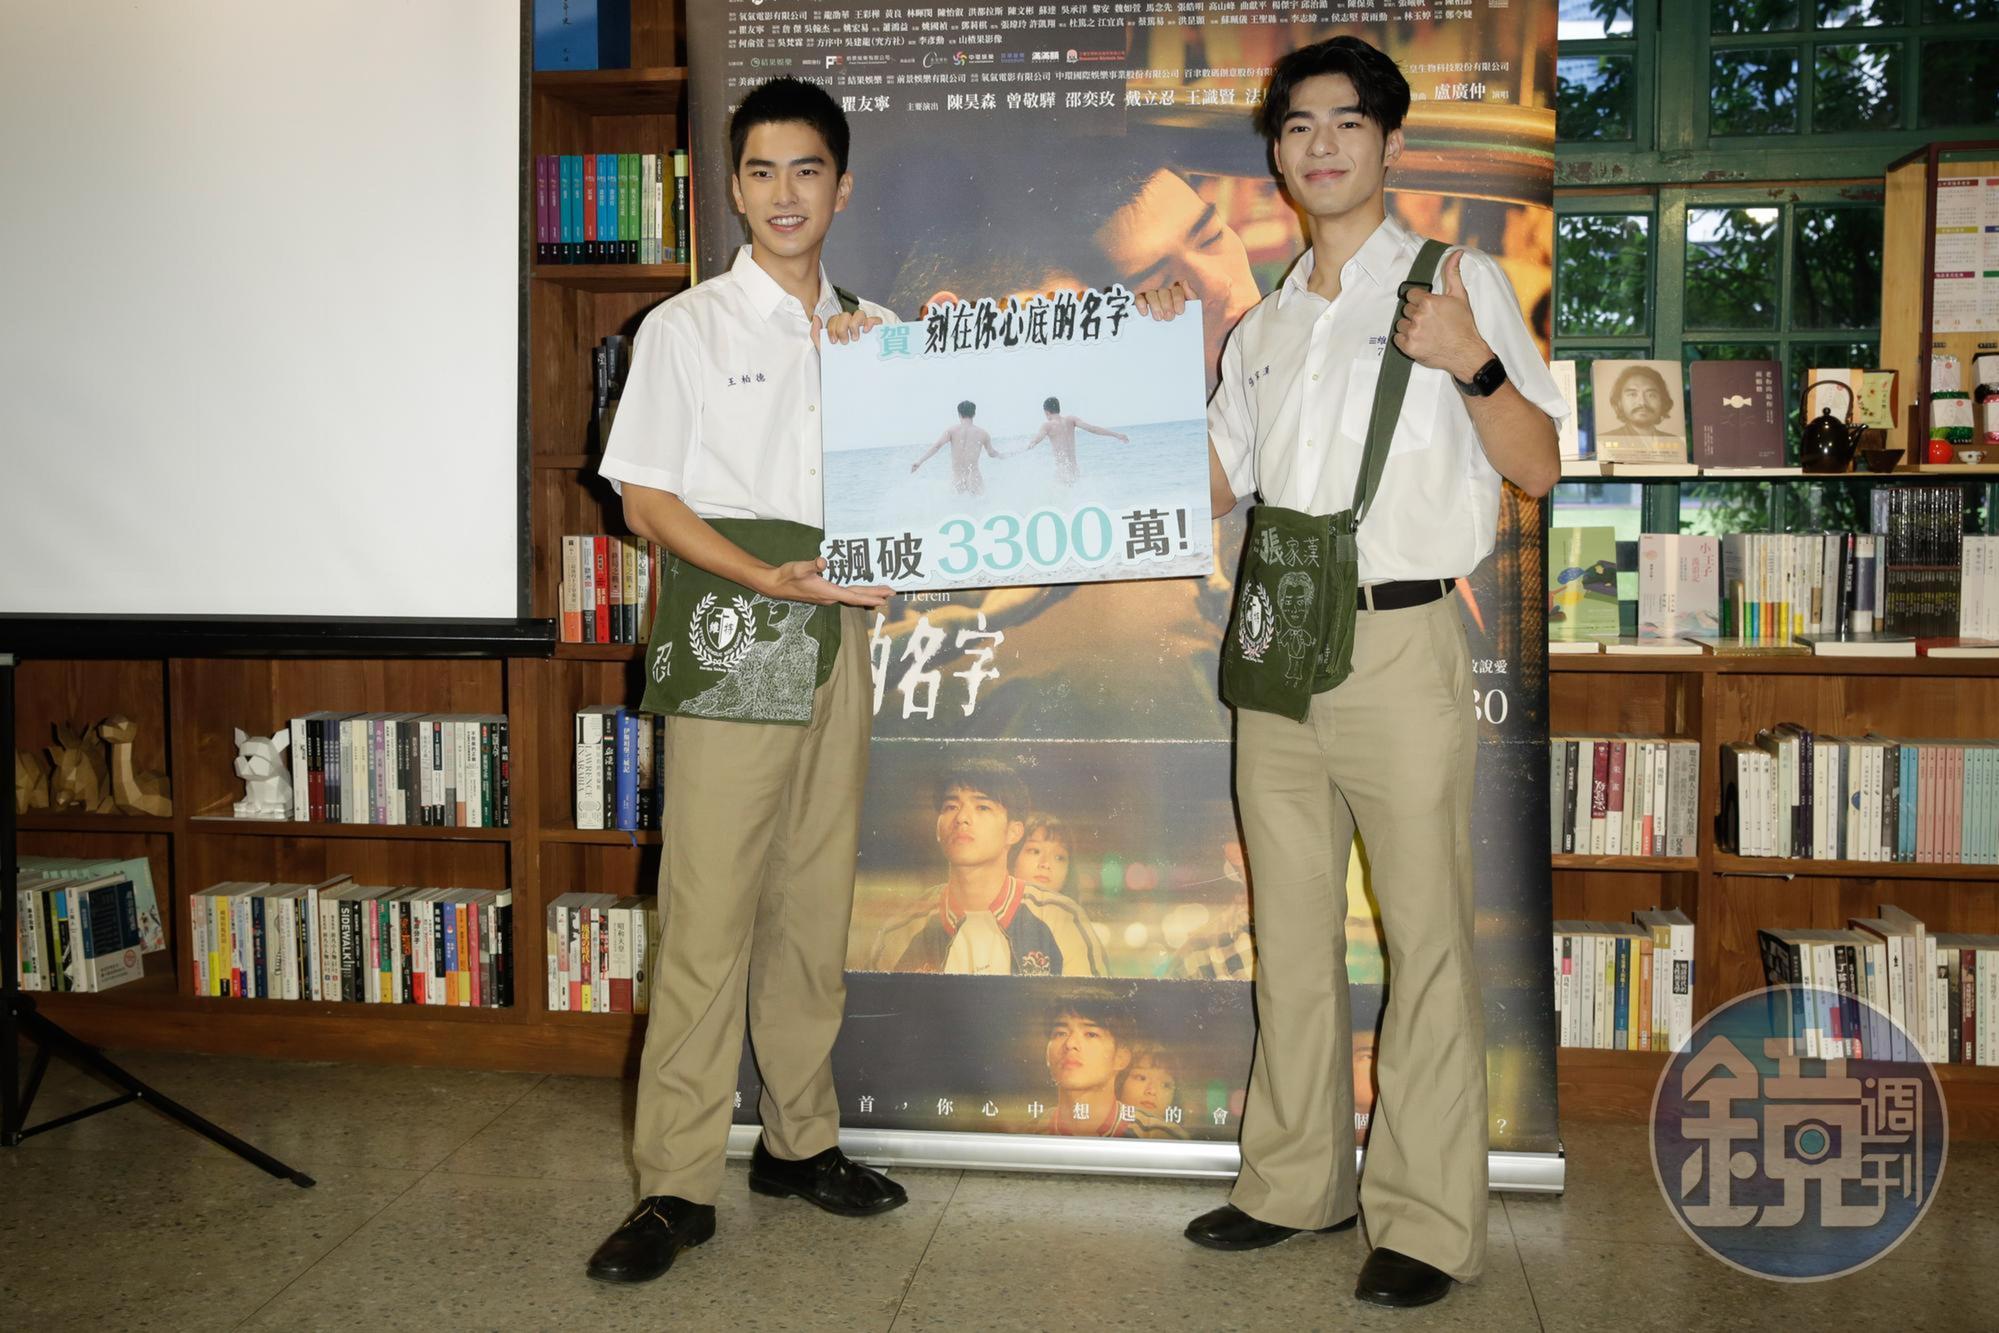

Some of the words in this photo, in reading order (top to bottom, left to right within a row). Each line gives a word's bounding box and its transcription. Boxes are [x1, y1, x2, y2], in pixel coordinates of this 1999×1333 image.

[739, 11, 808, 21] 氧氣電影有限公司
[855, 9, 880, 19] 王彩樺
[968, 7, 1003, 17] 洪都拉斯
[1115, 3, 1141, 13] 魏如萱
[1146, 3, 1172, 13] 馬念先
[1070, 18, 1095, 28] 杜篤之
[1331, 13, 1359, 23] 侯志堅
[817, 37, 842, 47] 方序中
[847, 75, 883, 86] 結果娛樂
[981, 71, 1051, 82] 氧氣電影有限公司
[842, 95, 890, 113] 瞿友寧
[907, 102, 939, 111] 主要演出
[947, 93, 997, 111] 陳昊森
[1007, 91, 1056, 109] 曾敬驊
[1065, 90, 1115, 108] 邵奕玫
[1126, 89, 1175, 107] 戴立忍
[1186, 88, 1235, 106] 王識賢
[1434, 82, 1486, 101] 盧廣仲
[879, 325, 911, 357] 賀
[923, 285, 1134, 355] 刻在你心底的名字
[825, 532, 926, 586] 飆破
[937, 506, 1114, 577] 3300
[904, 592, 950, 602] Herein
[1496, 1118, 1508, 1135] ?
